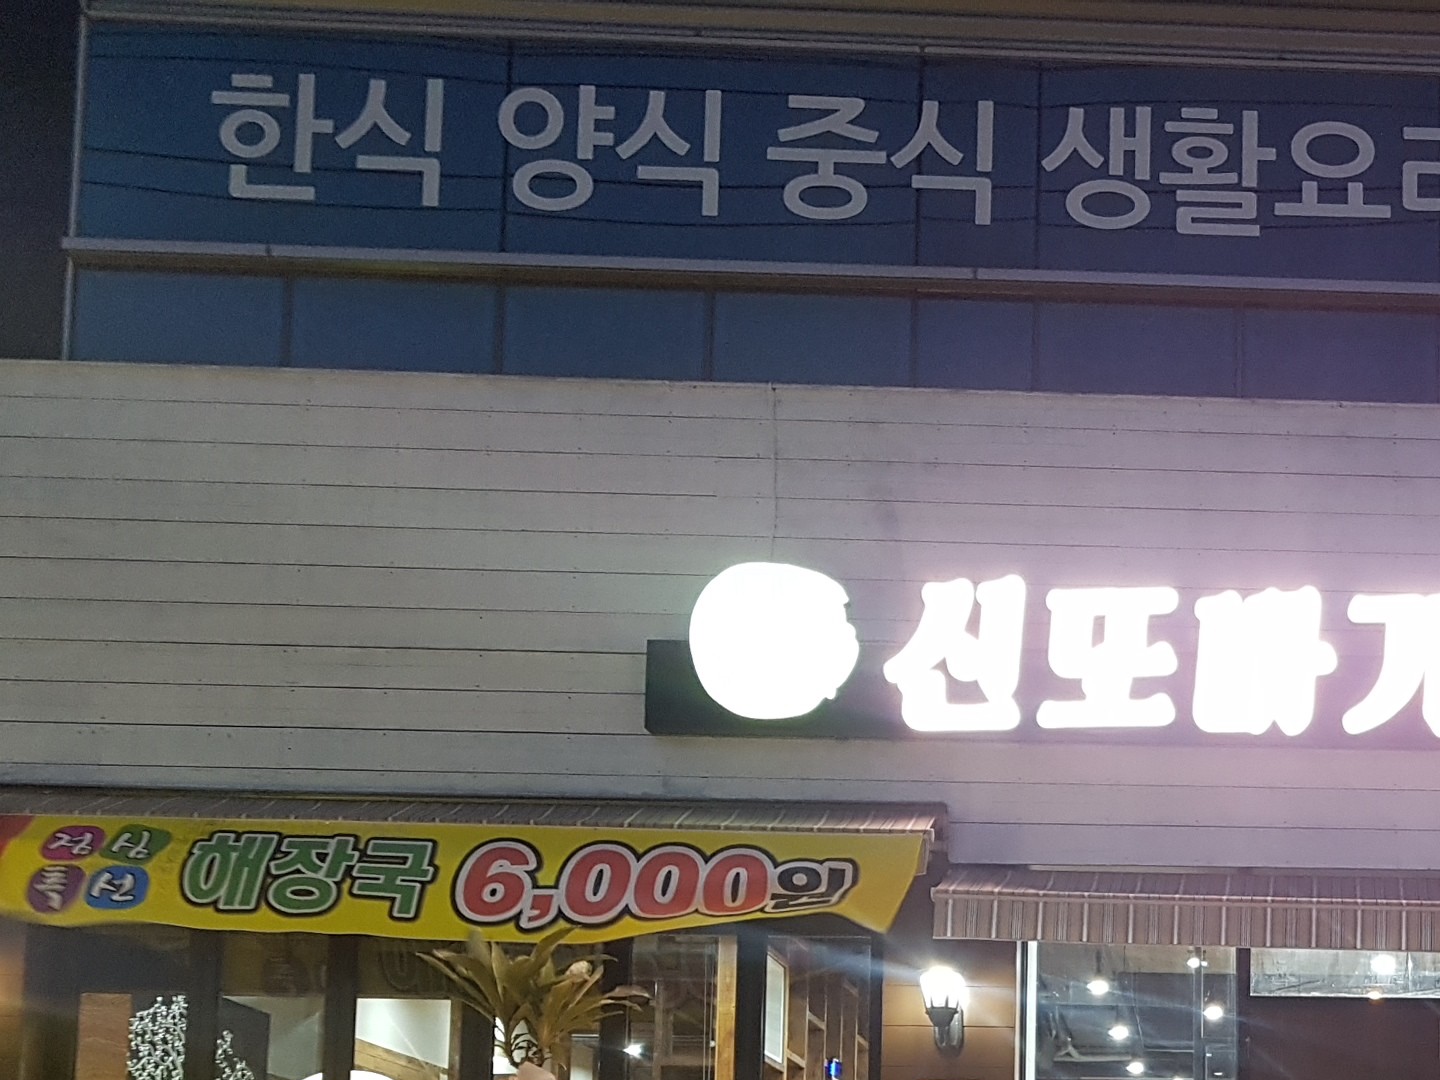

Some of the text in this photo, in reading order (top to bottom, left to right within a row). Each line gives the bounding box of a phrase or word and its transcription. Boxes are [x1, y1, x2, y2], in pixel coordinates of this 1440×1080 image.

[212, 73, 444, 207] 한식
[498, 84, 722, 217] 양식
[767, 94, 994, 226] 중식
[47, 830, 154, 860] 점심
[184, 832, 854, 927] 해장국 6,000원
[33, 866, 136, 910] 특선
